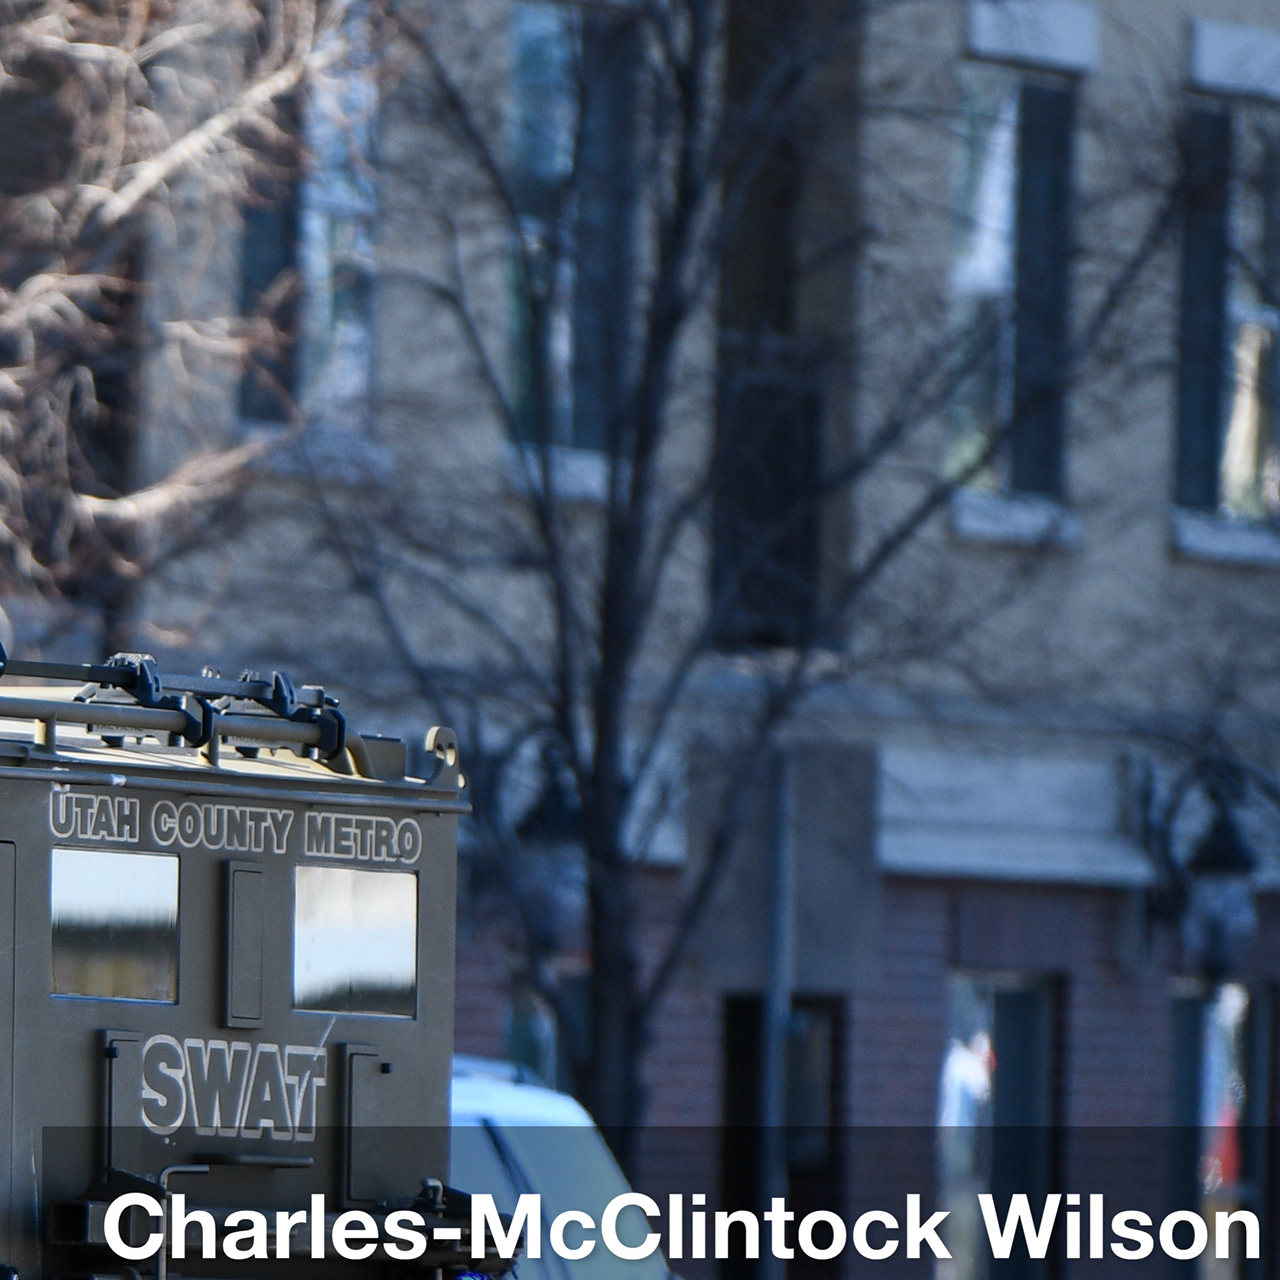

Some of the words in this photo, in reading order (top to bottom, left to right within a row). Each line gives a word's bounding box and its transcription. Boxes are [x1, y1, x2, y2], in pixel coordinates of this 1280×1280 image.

[50, 791, 139, 842] UTAH
[152, 801, 294, 854] COUNTY
[305, 812, 422, 864] METRO
[141, 1034, 327, 1141] SWAT
